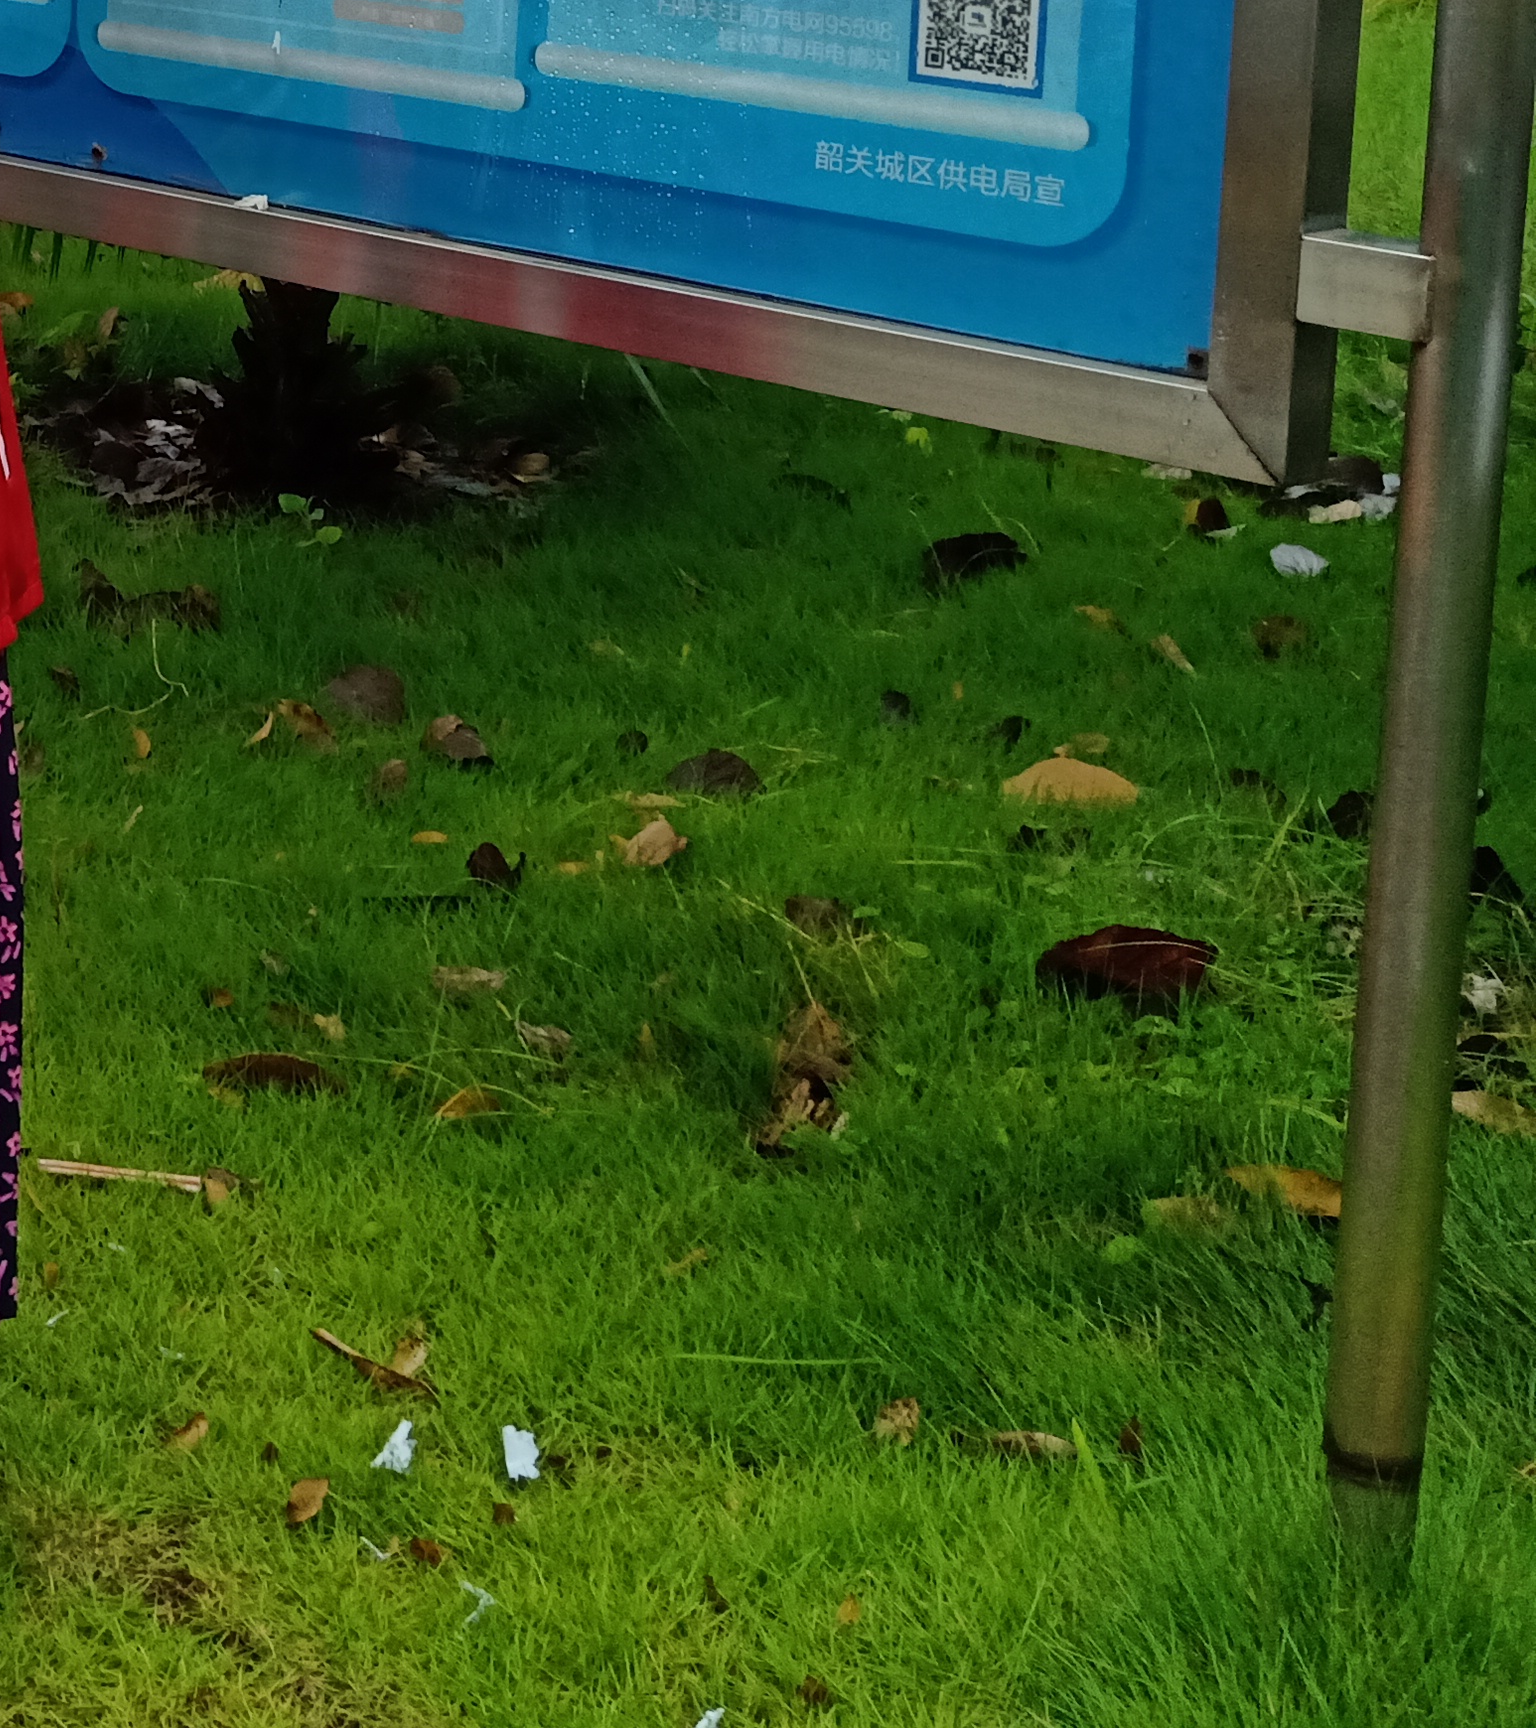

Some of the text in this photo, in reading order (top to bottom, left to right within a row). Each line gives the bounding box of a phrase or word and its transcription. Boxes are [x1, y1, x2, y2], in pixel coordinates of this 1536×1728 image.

[814, 139, 1066, 208] 韶关城区供电局宣
